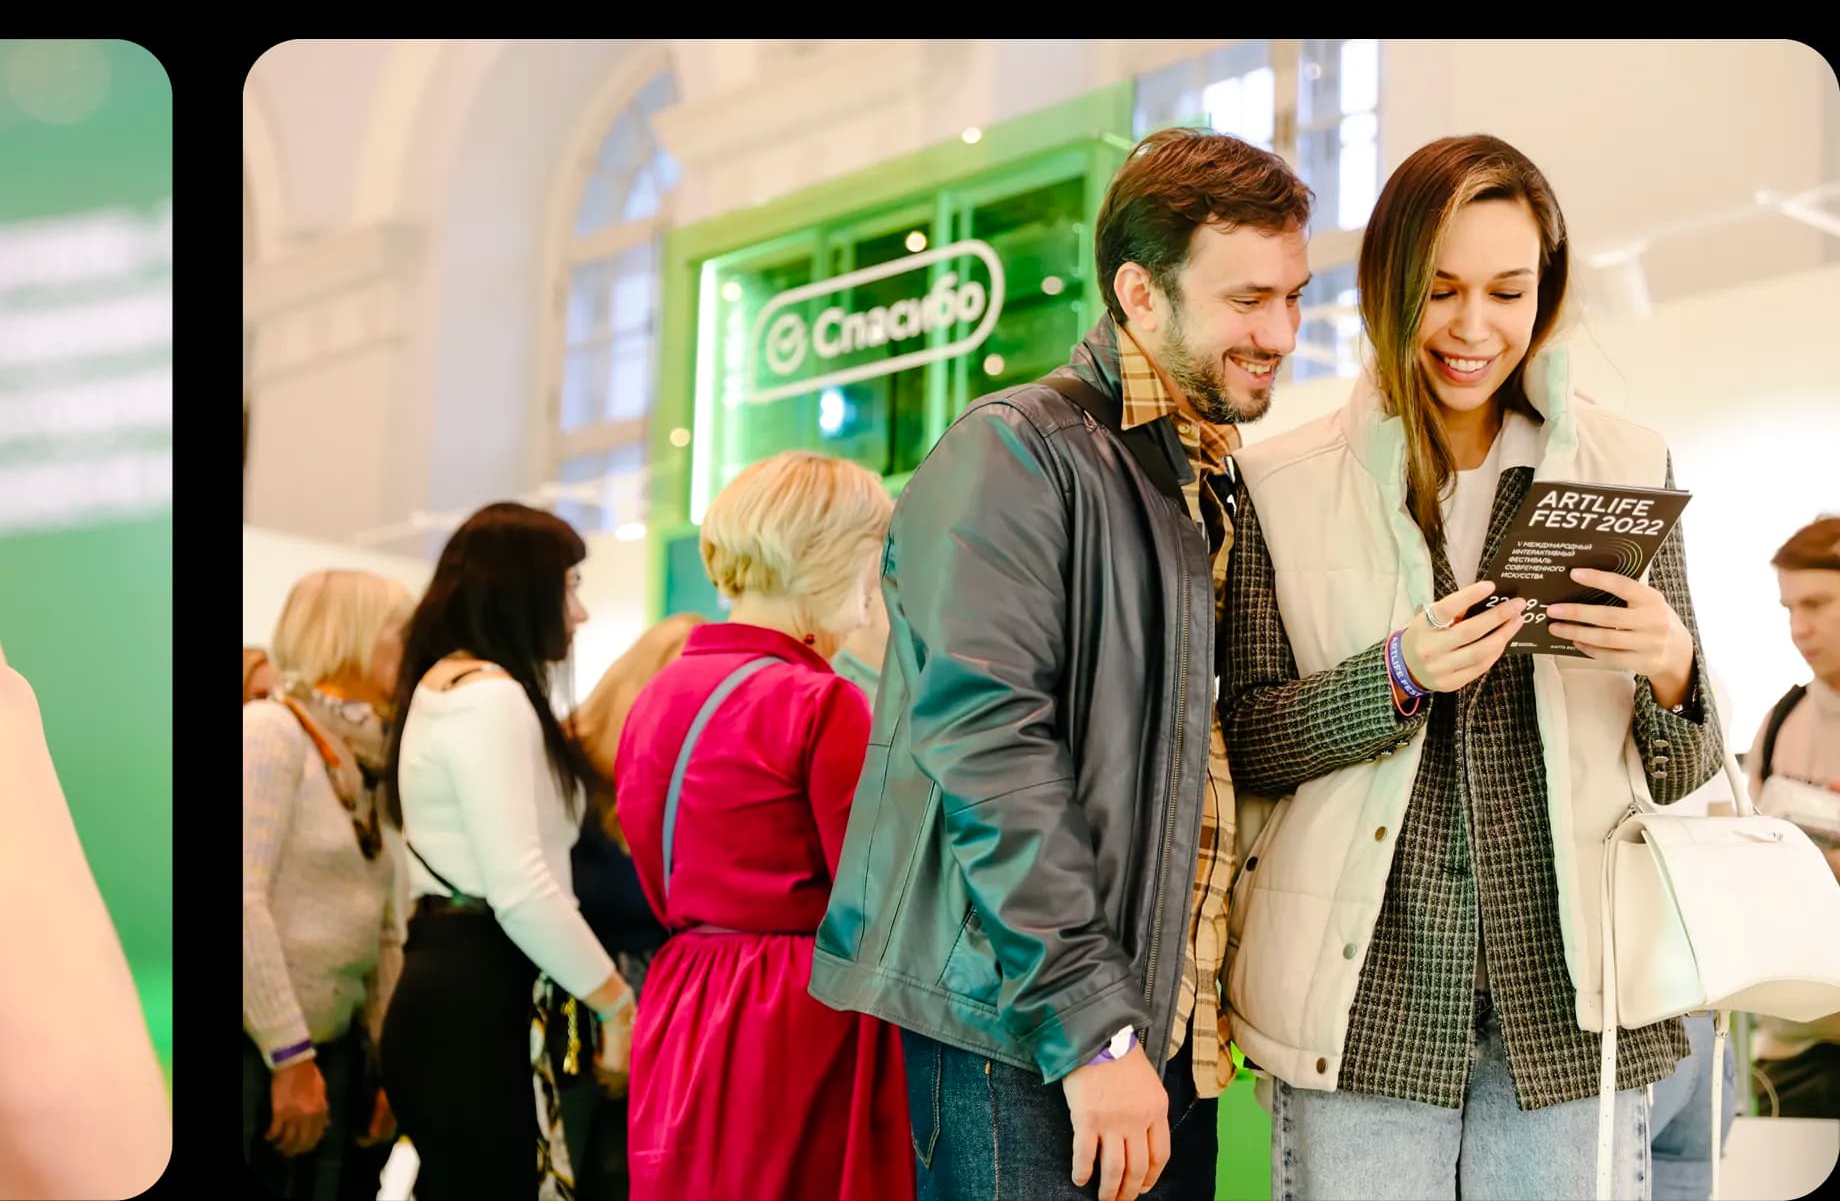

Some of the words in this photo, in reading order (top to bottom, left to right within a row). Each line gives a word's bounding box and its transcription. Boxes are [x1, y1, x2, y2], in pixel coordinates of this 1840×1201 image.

[813, 271, 986, 358] Спасибо
[1537, 490, 1655, 516] ARTLIFE
[1528, 510, 1598, 529] FEST
[1596, 516, 1664, 536] 2022
[1523, 541, 1592, 551] МЕЖДУНАРОДНЫЙ
[1512, 548, 1576, 557] ИНТЕРАКТИВНЫЙ
[1508, 556, 1552, 564] ФЕСТИВАЛЬ
[1505, 564, 1566, 572] СОВРЕМЕННОГО
[1500, 572, 1544, 580] ИСКУССТВА
[1390, 637, 1403, 678] ARTLIFE
